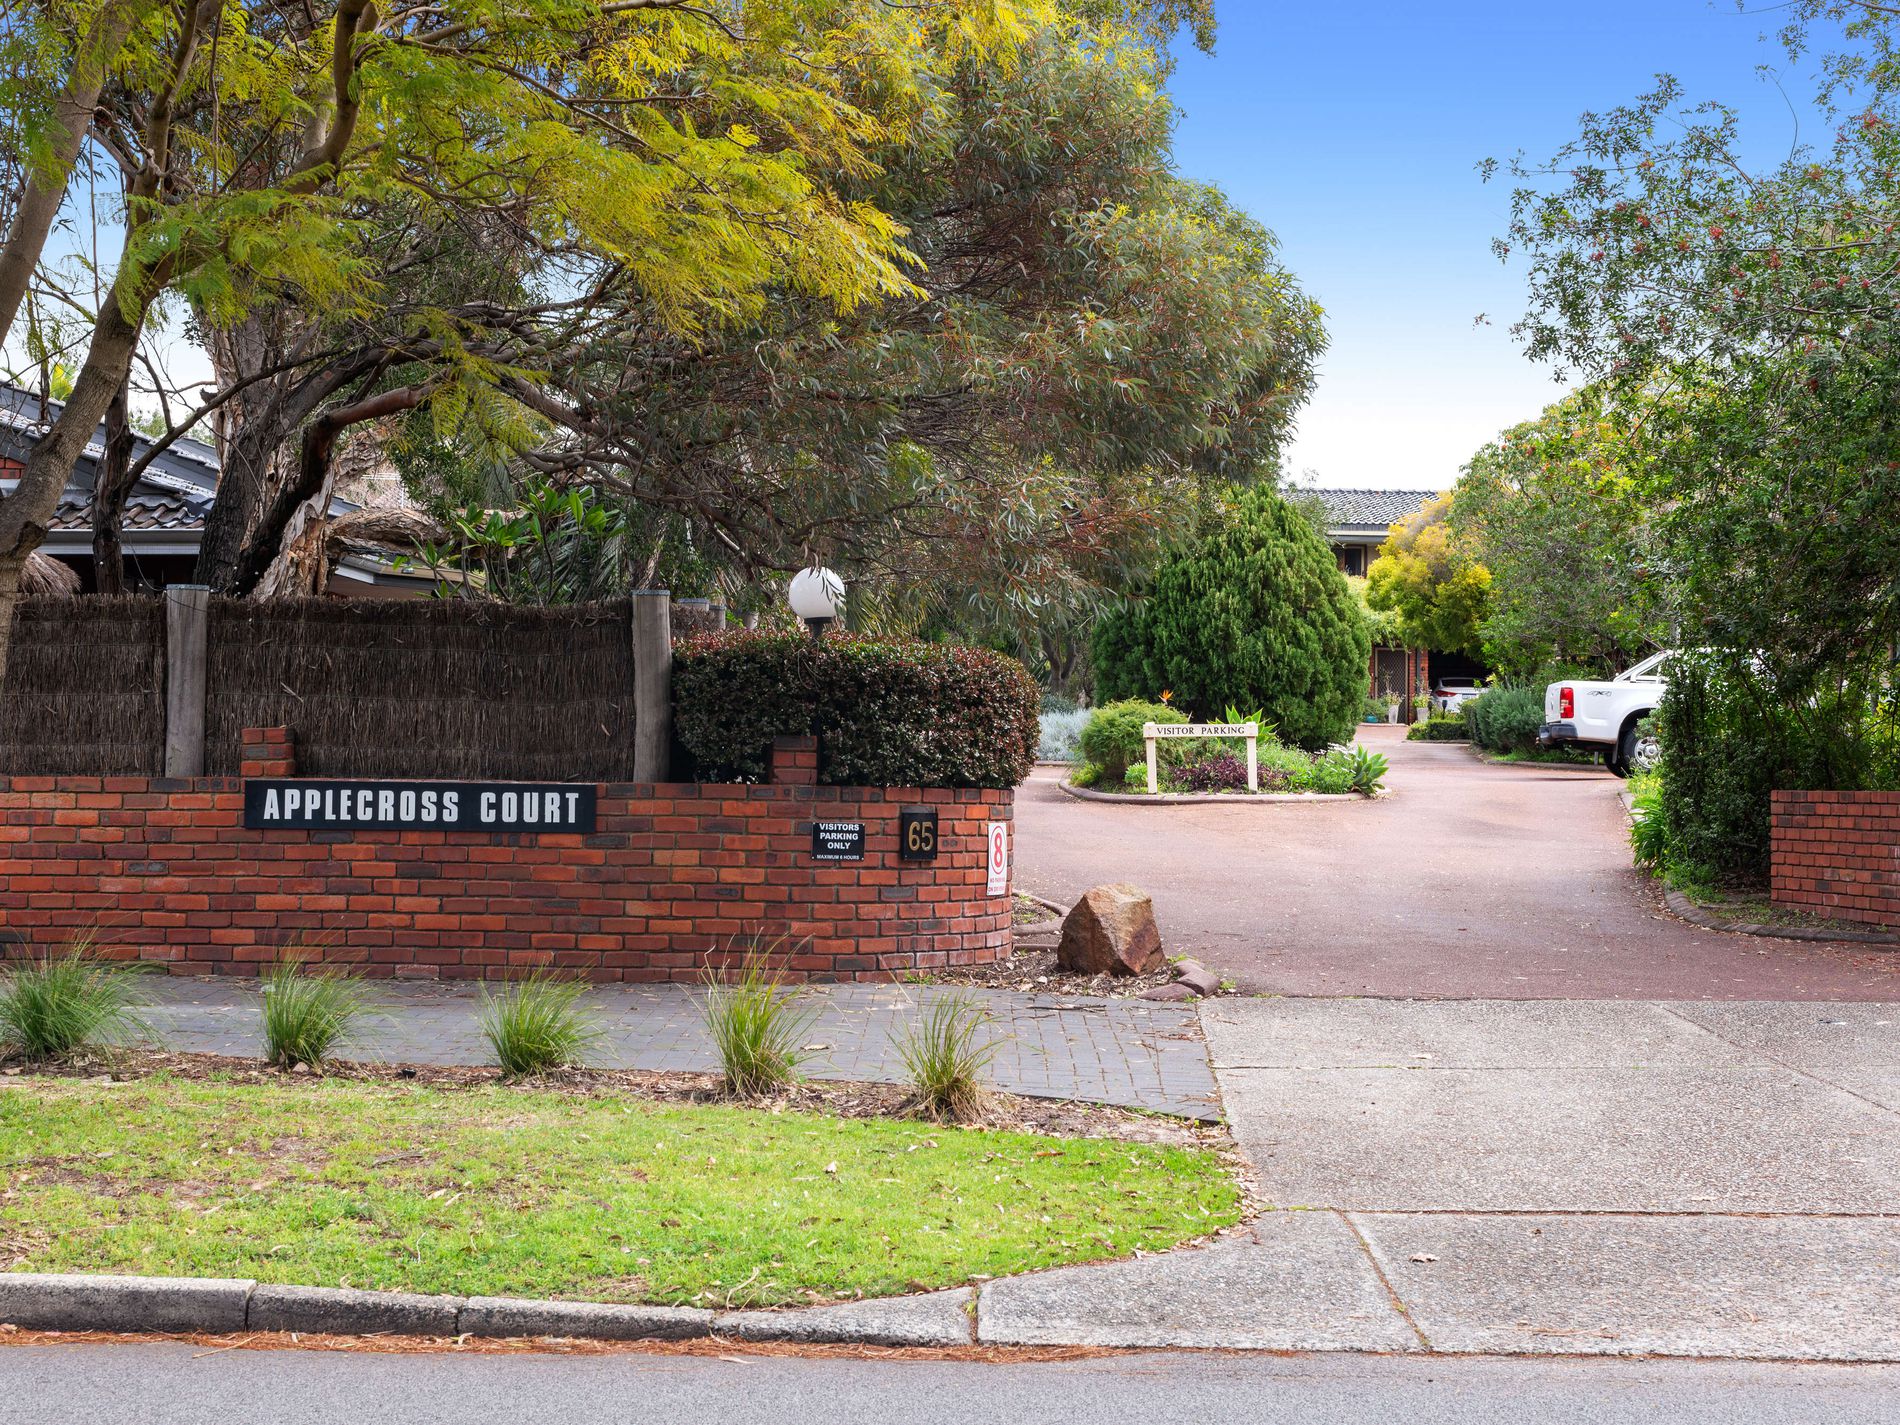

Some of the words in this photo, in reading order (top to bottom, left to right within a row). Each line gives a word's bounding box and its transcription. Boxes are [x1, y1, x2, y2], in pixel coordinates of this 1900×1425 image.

[1157, 727, 1195, 735] VISITOR
[1201, 727, 1245, 735] PARKING
[263, 788, 459, 822] APPLECROSS
[480, 791, 579, 824] COURT
[819, 823, 860, 831] VISITORS
[820, 832, 858, 840] PARKING
[908, 821, 934, 851] 65
[993, 832, 1003, 868] 8
